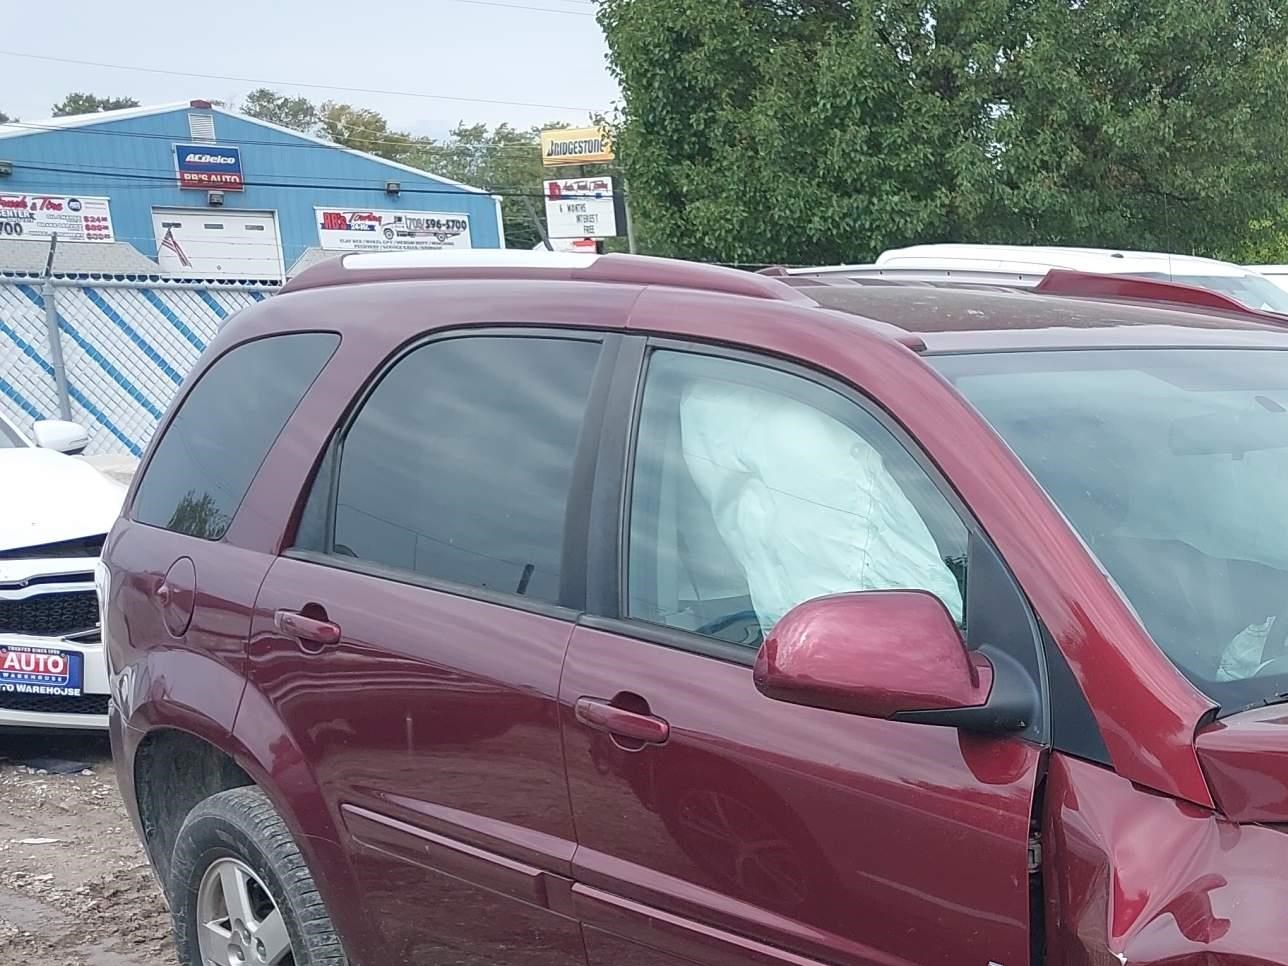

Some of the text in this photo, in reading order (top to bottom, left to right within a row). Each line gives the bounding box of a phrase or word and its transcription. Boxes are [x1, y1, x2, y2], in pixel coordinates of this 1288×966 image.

[547, 139, 605, 156] BRIDGESTONE
[185, 153, 236, 164] ACDelco
[3, 652, 64, 673] AUTO
[2, 672, 62, 682] WAREHOUSE
